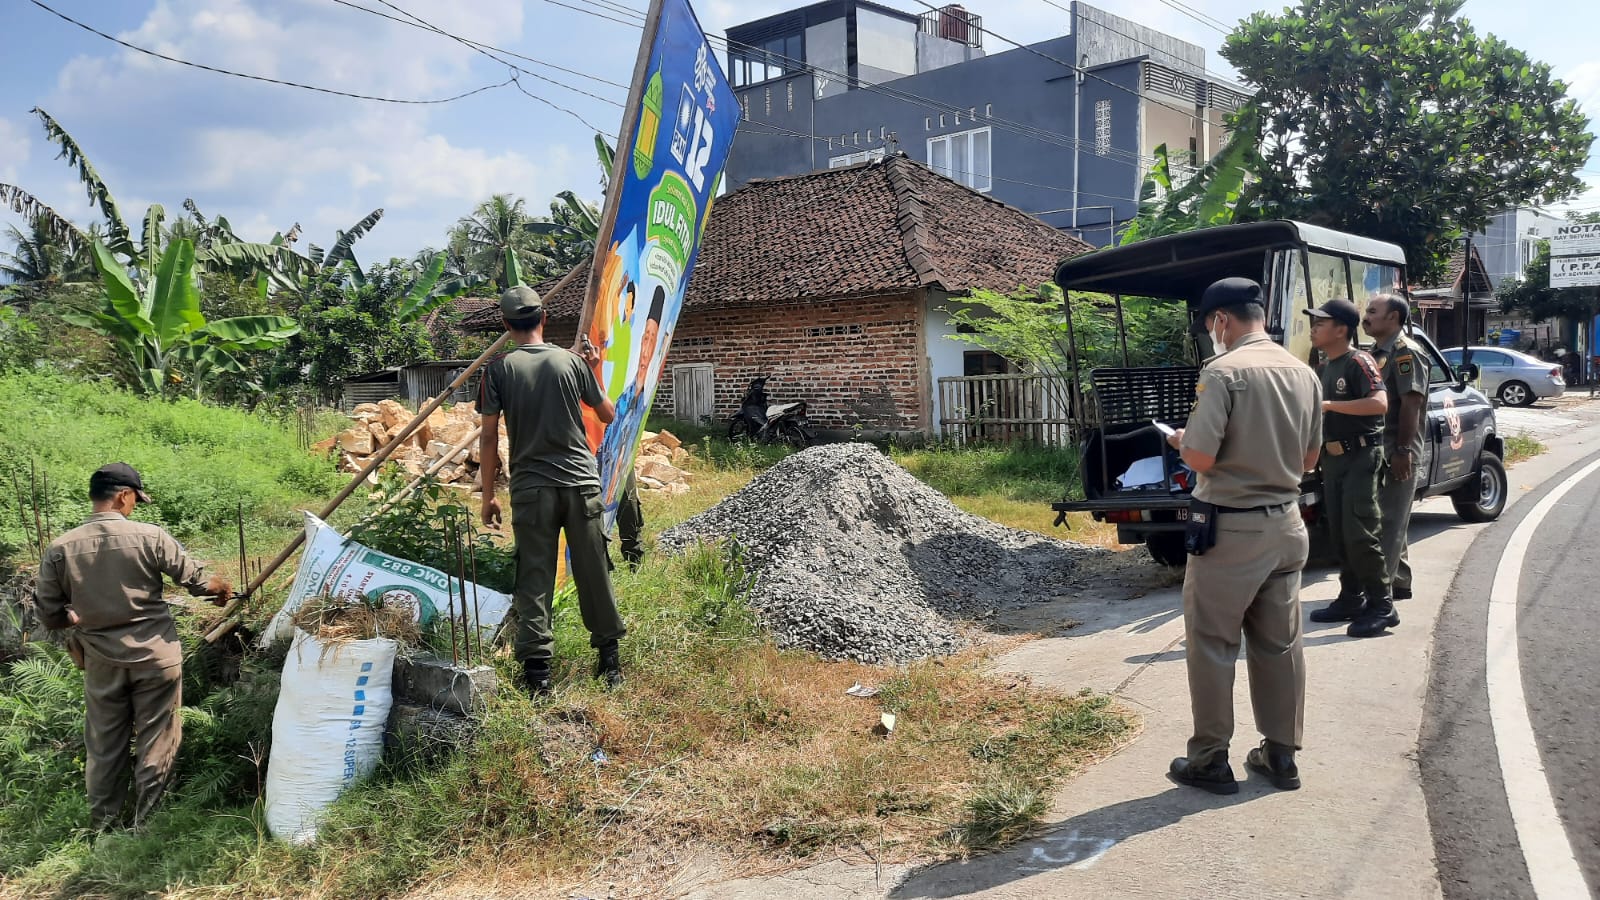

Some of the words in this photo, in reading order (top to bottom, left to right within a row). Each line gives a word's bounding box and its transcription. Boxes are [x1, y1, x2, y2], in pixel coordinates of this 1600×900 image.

[672, 131, 686, 157] PAN
[685, 105, 714, 193] 12
[652, 200, 676, 231] IDUL
[675, 213, 691, 258] FITRI
[1558, 224, 1600, 234] NOTA
[381, 558, 412, 575] 882
[413, 567, 449, 591] DMC
[343, 750, 356, 781] SUPER
